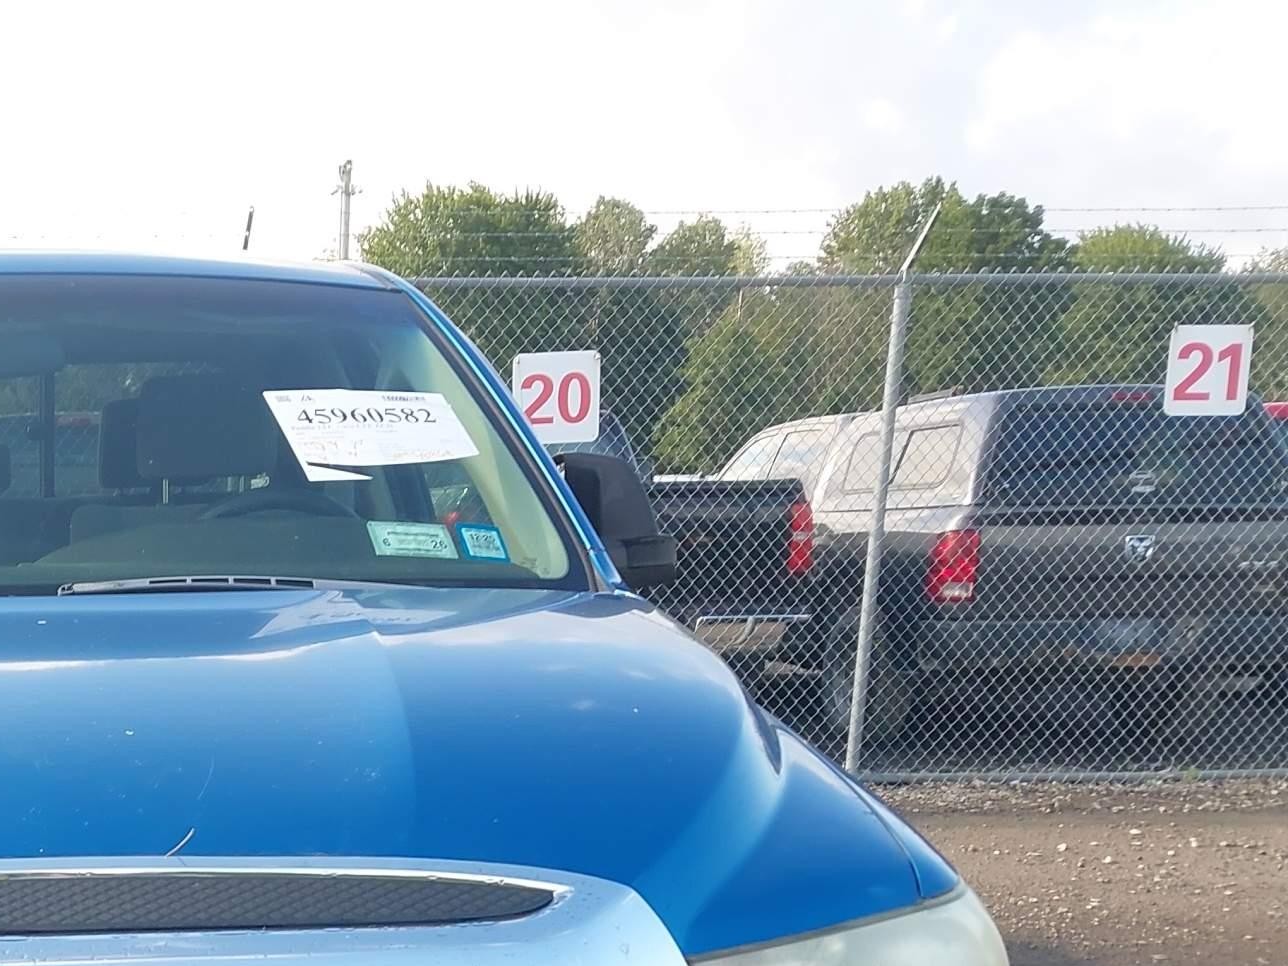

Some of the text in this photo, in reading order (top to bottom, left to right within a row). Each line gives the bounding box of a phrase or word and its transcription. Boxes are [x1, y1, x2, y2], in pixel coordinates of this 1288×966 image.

[520, 371, 592, 424] 20
[1172, 341, 1244, 401] 21
[297, 407, 437, 424] 45960582
